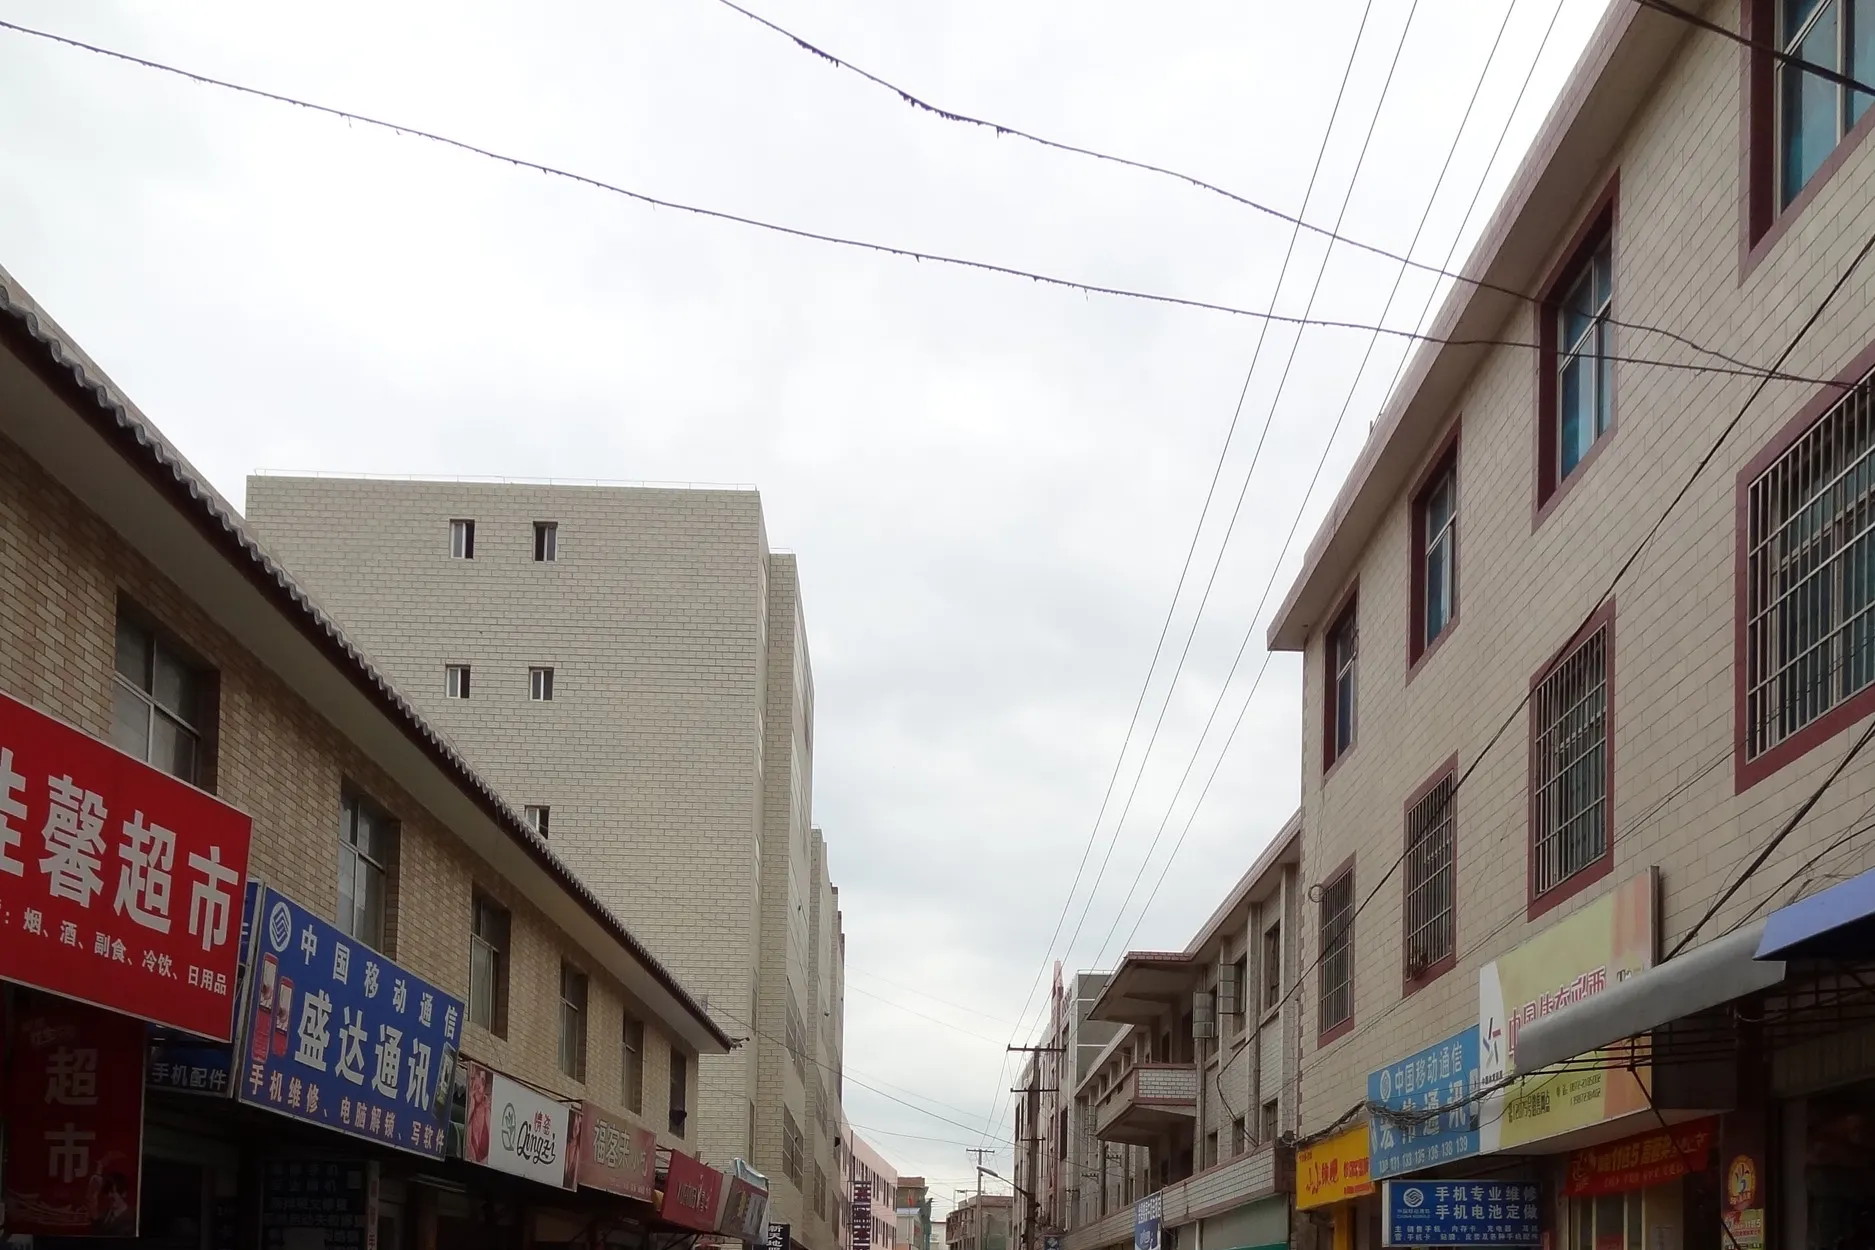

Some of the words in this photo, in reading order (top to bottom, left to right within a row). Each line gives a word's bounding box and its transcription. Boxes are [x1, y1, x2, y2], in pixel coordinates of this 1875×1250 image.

[0, 900, 227, 996] ：烟、酒、副食、冷饮、日用品
[301, 924, 458, 1040] 中国移动通信
[295, 989, 431, 1111] 盛达通讯
[1395, 1041, 1463, 1097] 中国移动通信
[152, 1062, 227, 1091] 手机配件
[44, 1046, 98, 1183] 超市
[517, 1120, 556, 1165] Qingzi
[1456, 1135, 1468, 1153] 139
[1435, 1186, 1538, 1202] 手机专业维修
[1435, 1204, 1538, 1220] 手机电池定做
